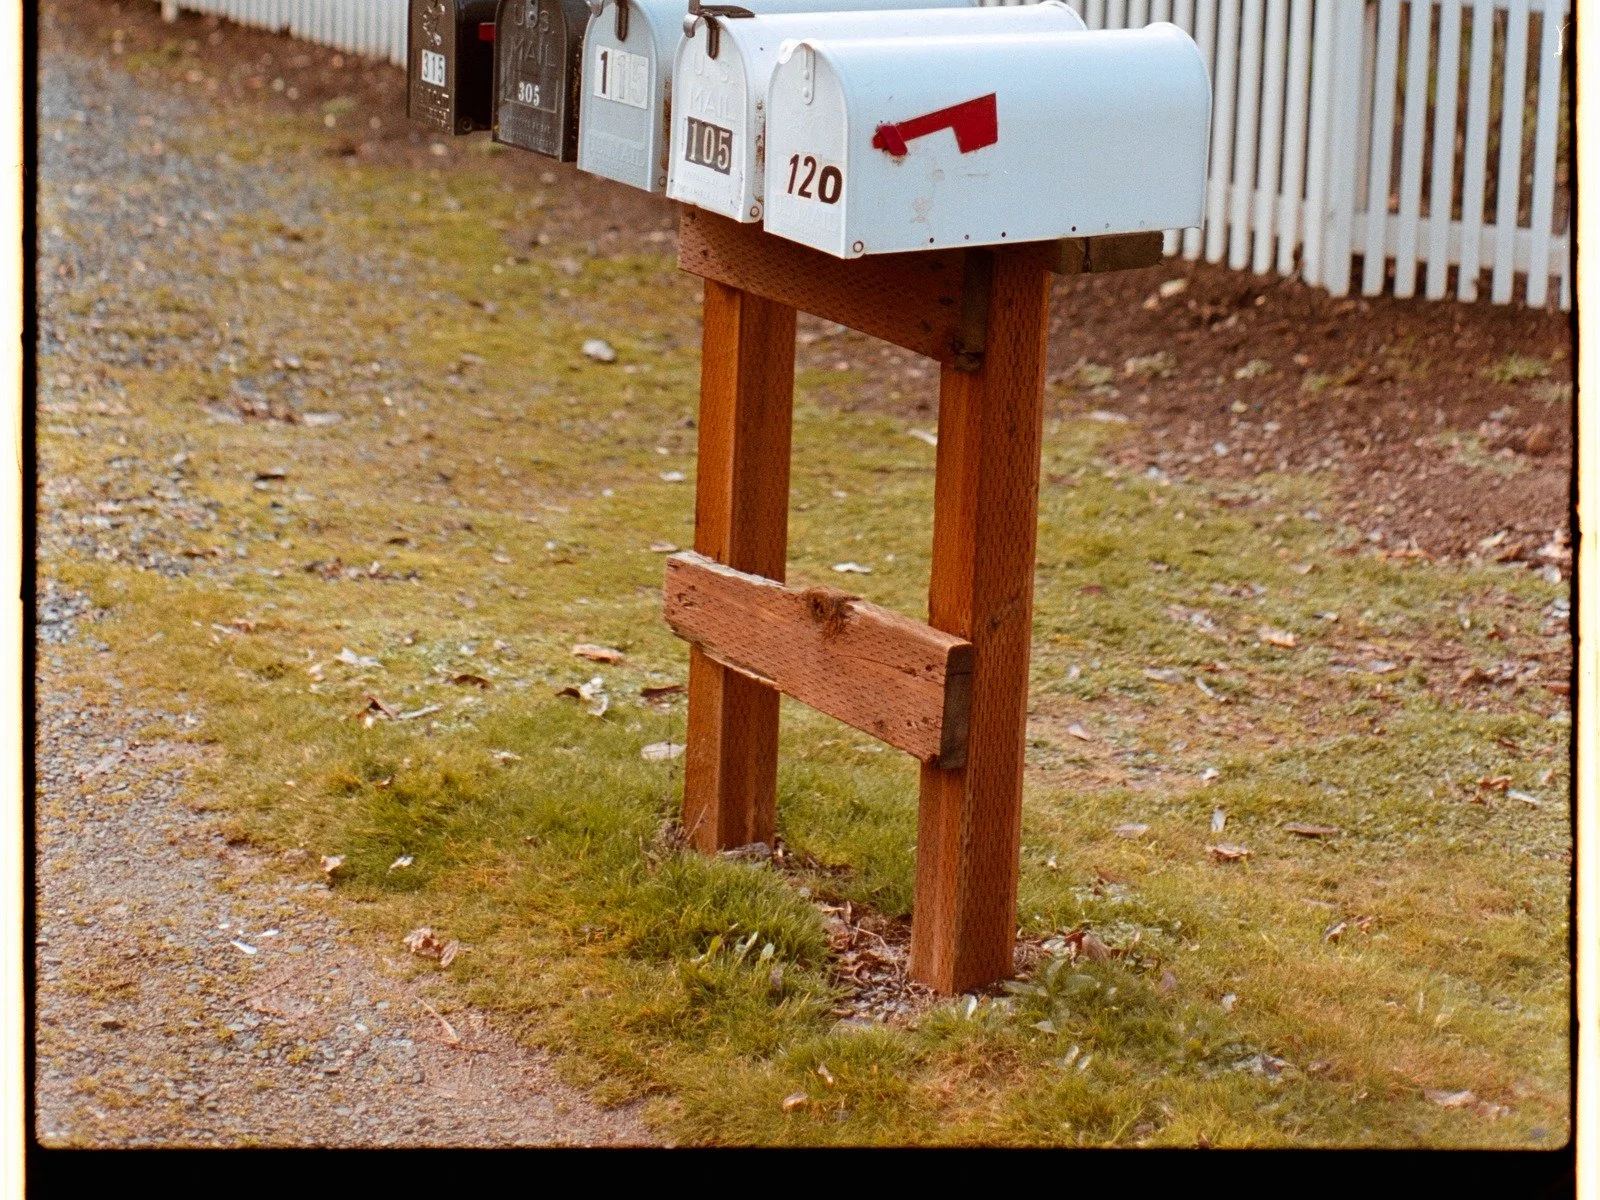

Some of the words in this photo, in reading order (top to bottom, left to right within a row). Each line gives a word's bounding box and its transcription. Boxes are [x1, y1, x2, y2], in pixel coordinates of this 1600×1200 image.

[423, 52, 444, 83] 315
[510, 36, 556, 68] MAIL
[518, 81, 541, 107] 305
[690, 87, 737, 124] MAIL
[689, 121, 730, 170] 105
[787, 153, 843, 205] 120
